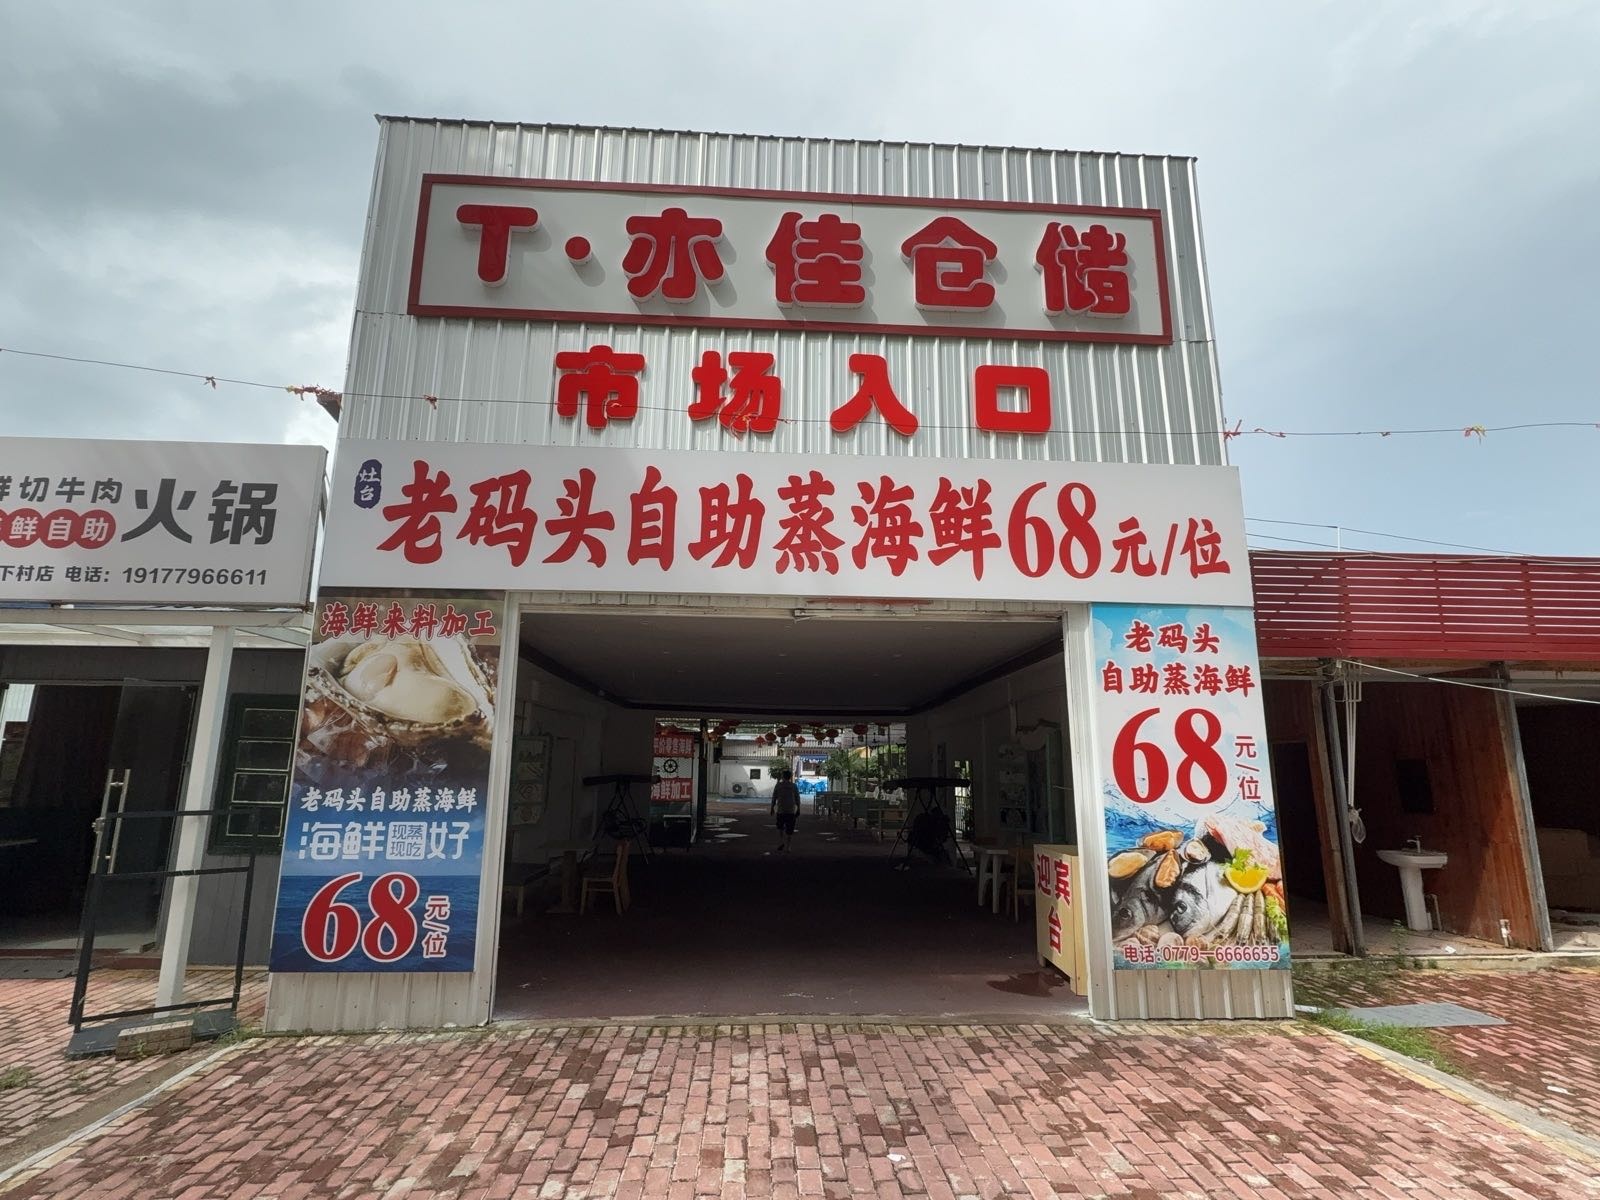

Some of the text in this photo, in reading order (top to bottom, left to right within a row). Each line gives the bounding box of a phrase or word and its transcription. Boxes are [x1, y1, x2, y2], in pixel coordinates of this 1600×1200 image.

[555, 344, 1051, 436] 市场入口
[359, 466, 381, 501] 灶台
[0, 514, 110, 542] 鲜自助
[121, 478, 278, 545] 火锅
[319, 601, 497, 640] 海鲜来料加工
[1124, 620, 1220, 654] 老码头
[1101, 662, 1255, 697] 自助蒸海鲜
[1112, 707, 1228, 805] 68
[300, 786, 478, 813] 老码头自助蒸海鲜
[301, 871, 421, 963] 68
